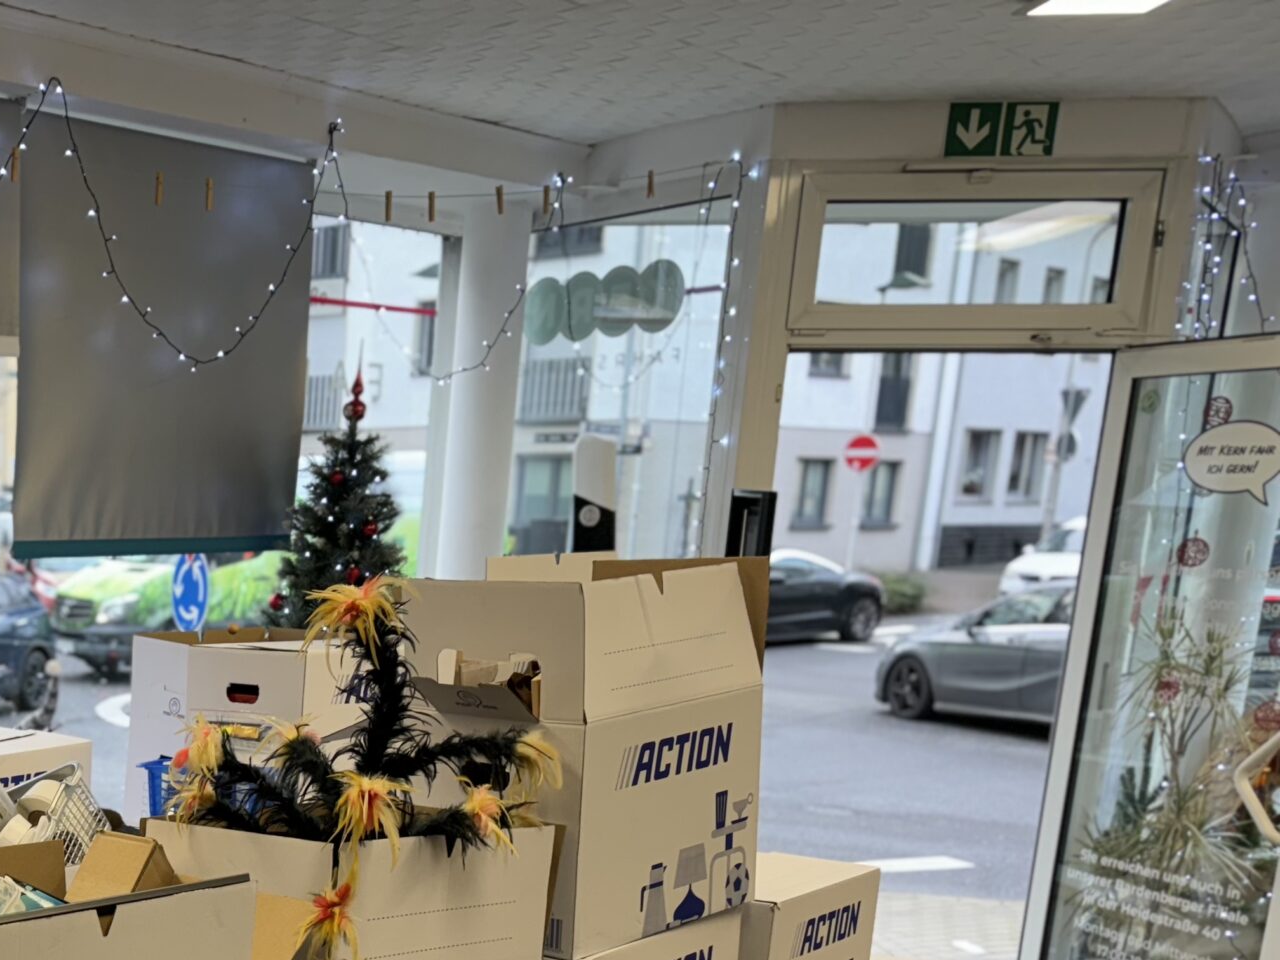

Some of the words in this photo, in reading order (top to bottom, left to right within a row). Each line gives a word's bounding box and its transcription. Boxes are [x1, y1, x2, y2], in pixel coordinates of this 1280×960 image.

[1197, 444, 1217, 457] MIT
[1218, 444, 1247, 457] KERN
[1248, 444, 1277, 456] FAHR
[1206, 463, 1224, 475] ICH
[1225, 459, 1259, 474] GERN!
[631, 722, 734, 787] ACTION
[1080, 848, 1098, 864] Sie
[1100, 857, 1161, 880] erreichen
[1189, 878, 1224, 897] auch
[1114, 881, 1205, 914] Bardenberger
[1207, 905, 1250, 926] Filiale
[1121, 901, 1199, 936] Heidestraße
[1202, 926, 1221, 942] 40
[800, 901, 862, 957] ACTION
